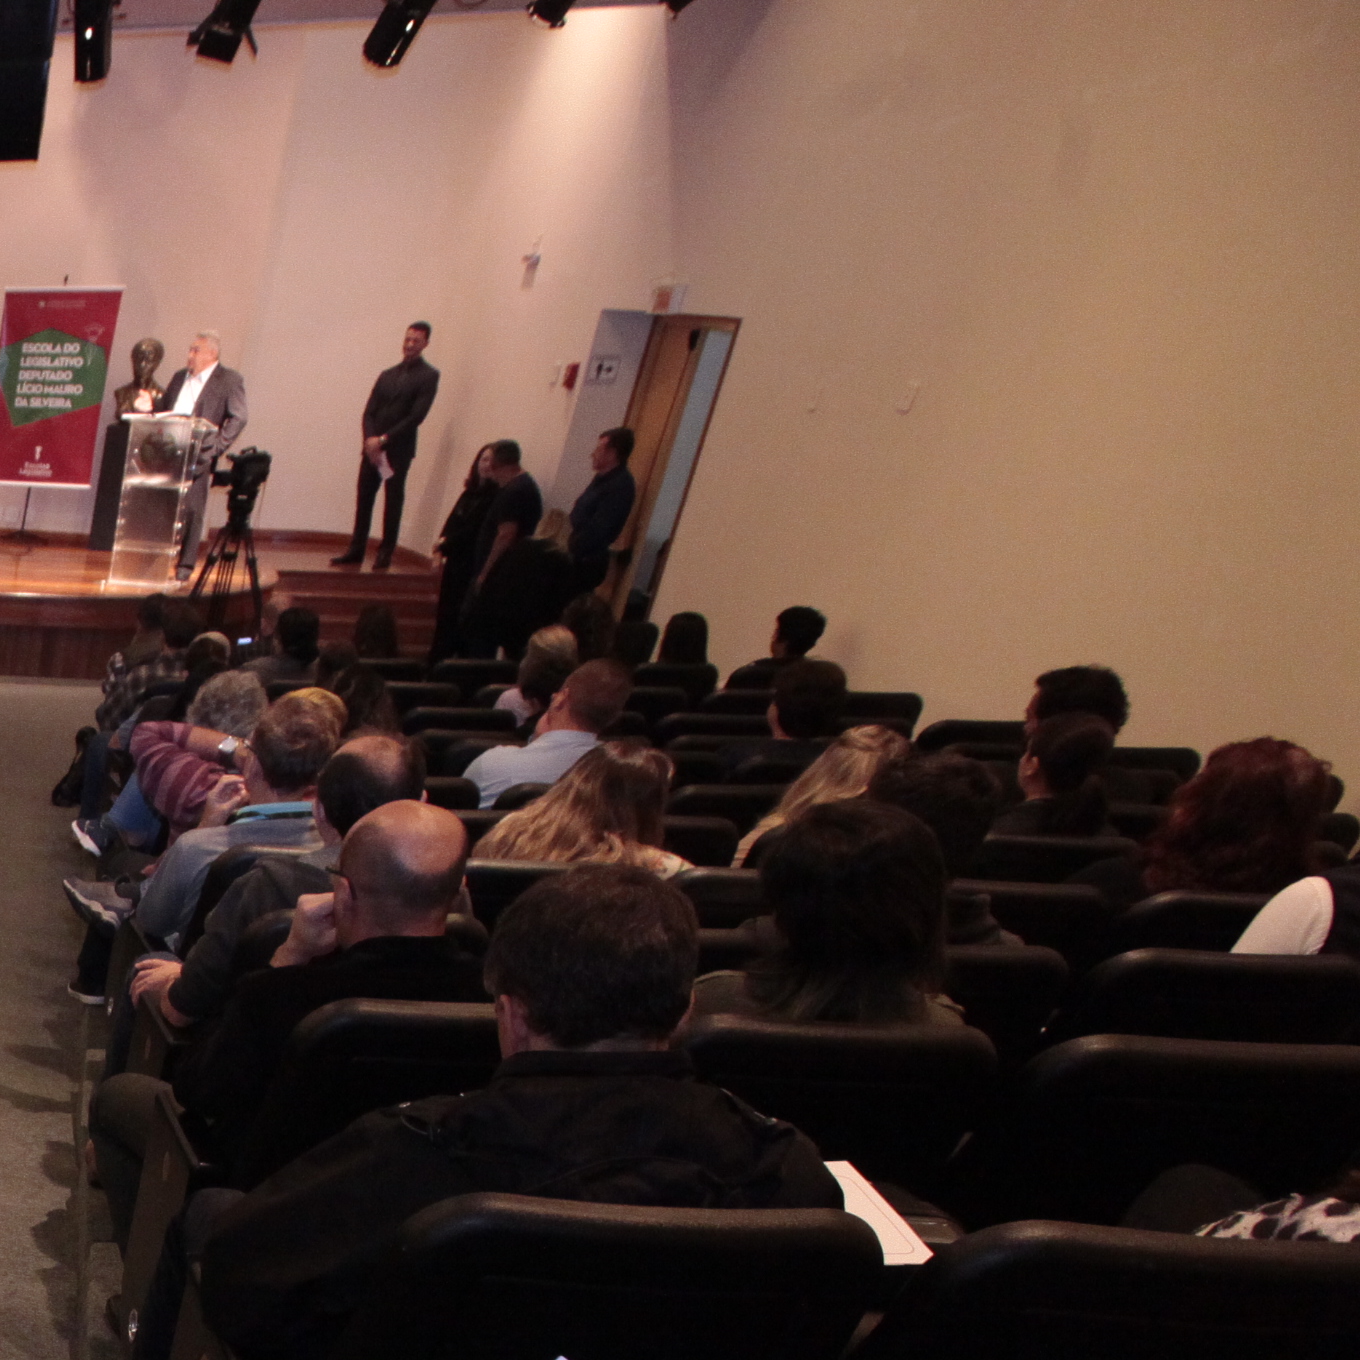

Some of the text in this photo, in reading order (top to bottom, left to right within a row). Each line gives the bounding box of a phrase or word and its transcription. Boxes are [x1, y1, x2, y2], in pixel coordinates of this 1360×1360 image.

[22, 342, 81, 353] ESCOLA DO
[20, 356, 84, 367] LEGISLATIVO
[18, 370, 73, 381] DEPUTADO
[44, 384, 84, 395] MAURO
[15, 397, 72, 408] DA SILVEIRA
